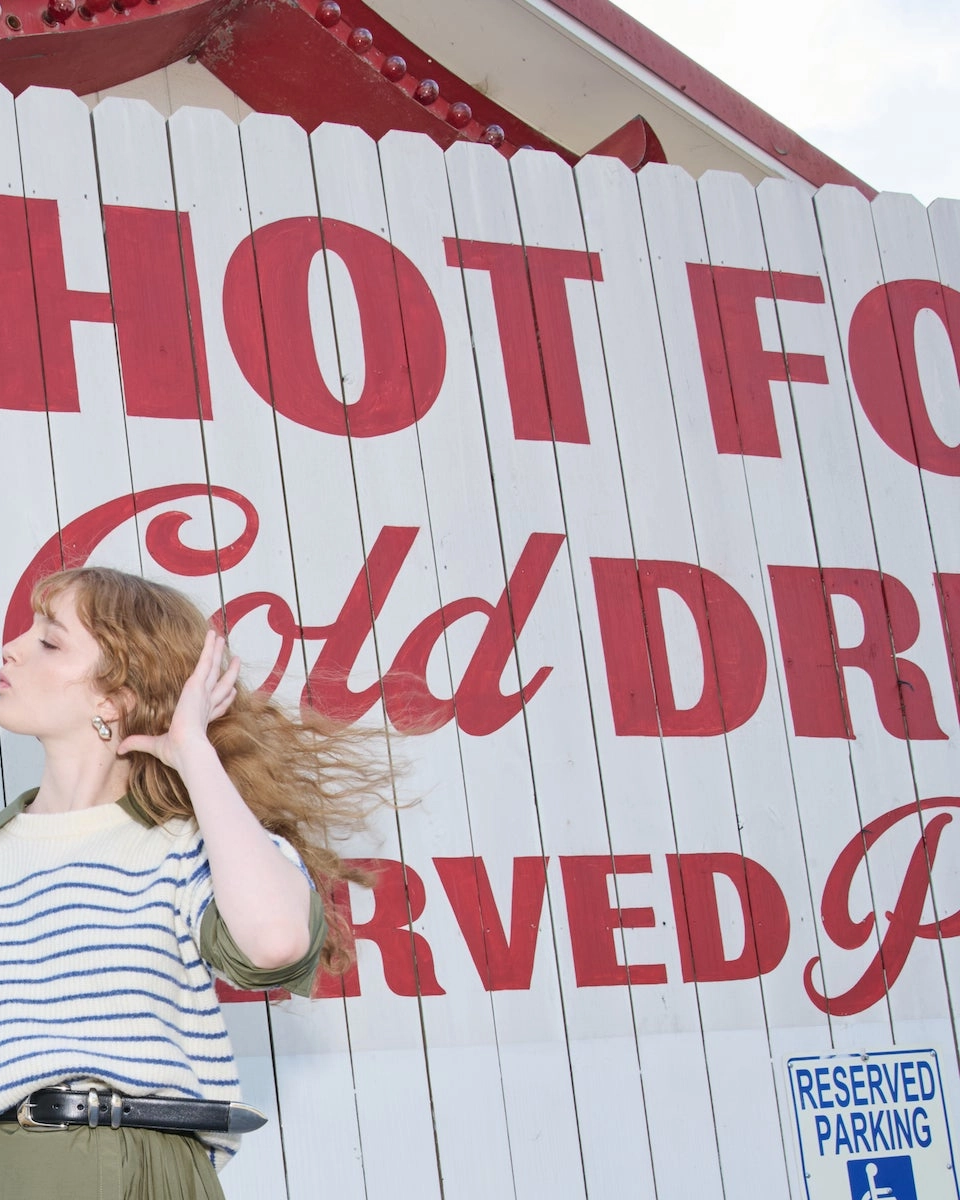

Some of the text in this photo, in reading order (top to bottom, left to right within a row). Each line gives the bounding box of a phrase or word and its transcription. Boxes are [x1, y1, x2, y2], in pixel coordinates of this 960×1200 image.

[590, 557, 960, 740] DR
[796, 1061, 936, 1110] RESERVED
[815, 1107, 932, 1156] PARKING
